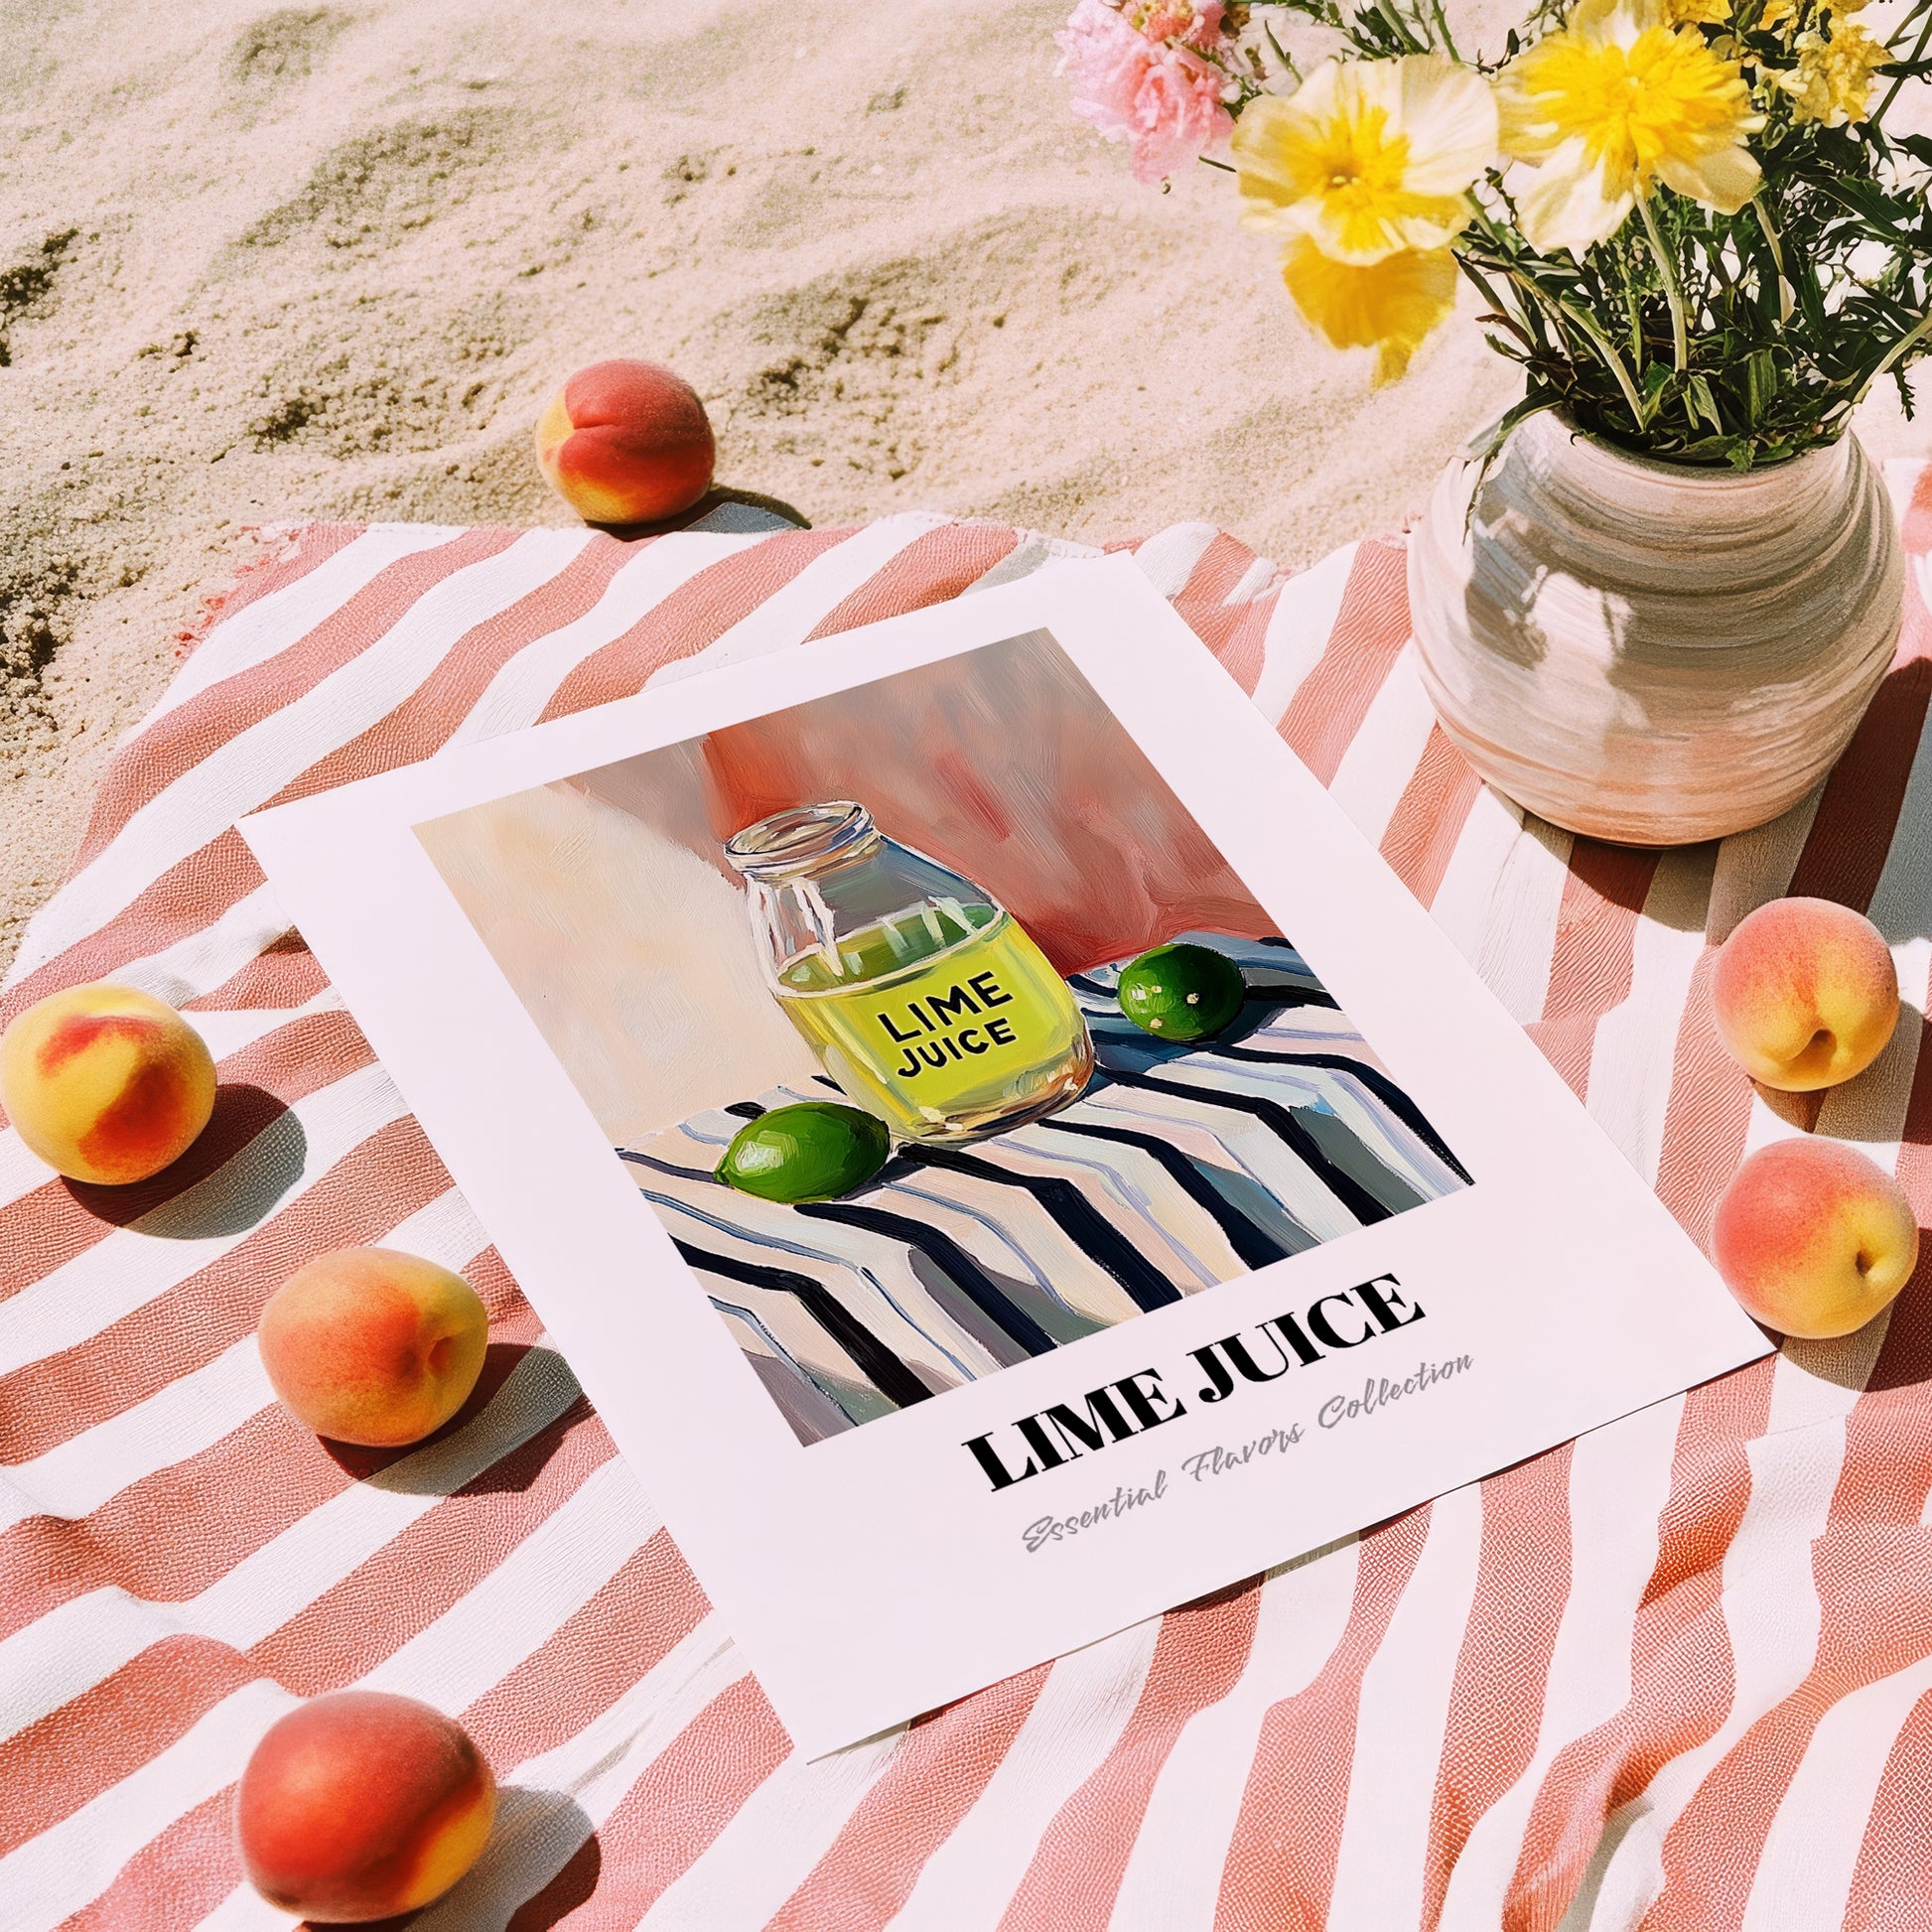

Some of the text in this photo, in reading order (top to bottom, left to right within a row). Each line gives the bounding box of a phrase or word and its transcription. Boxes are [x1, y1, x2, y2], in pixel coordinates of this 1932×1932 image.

[877, 971, 1014, 1042] LIME
[897, 1018, 1017, 1077] JUICE
[961, 1272, 1427, 1492] LIME JUICE
[1022, 1353, 1473, 1553] Essential Flavors Collection
